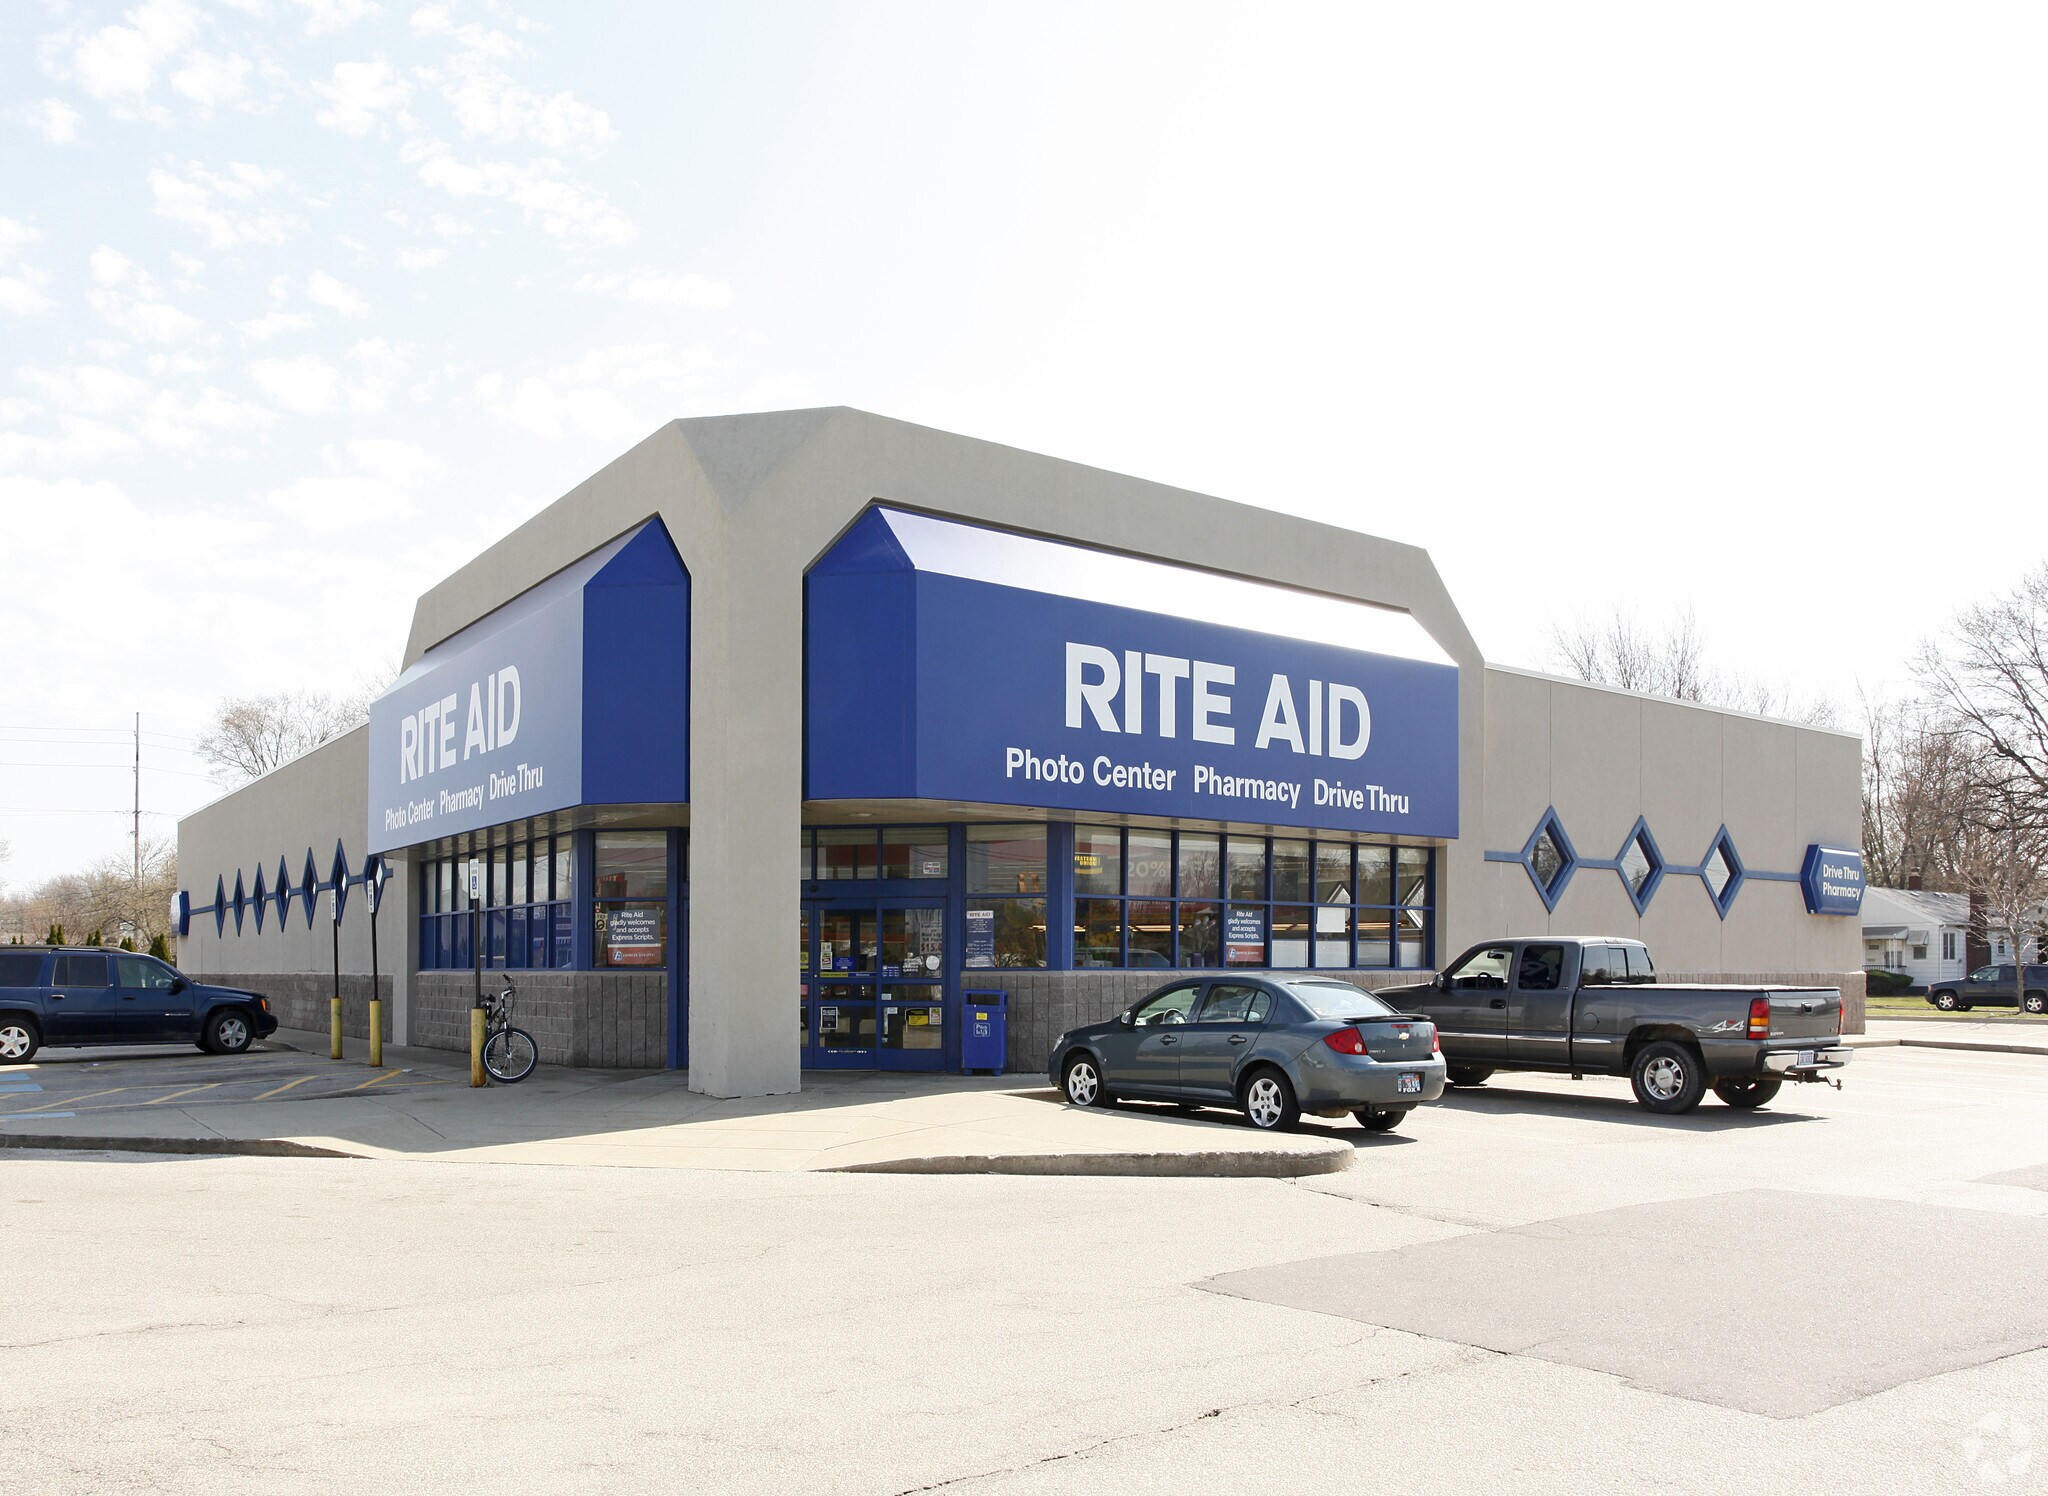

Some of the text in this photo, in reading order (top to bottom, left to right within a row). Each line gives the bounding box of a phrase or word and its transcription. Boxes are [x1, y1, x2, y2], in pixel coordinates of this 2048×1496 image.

[1065, 641, 1372, 761] RITE AID
[400, 664, 521, 785] RITE AID
[385, 762, 544, 832] Photo Center Pharmacy Drive Thru
[1005, 746, 1410, 815] Photo Center Pharmacy Drive Thru
[1128, 860, 1167, 878] 20%
[1822, 881, 1861, 902] Pharmacy
[1823, 864, 1860, 881] Drive Thru
[612, 934, 633, 942] Express
